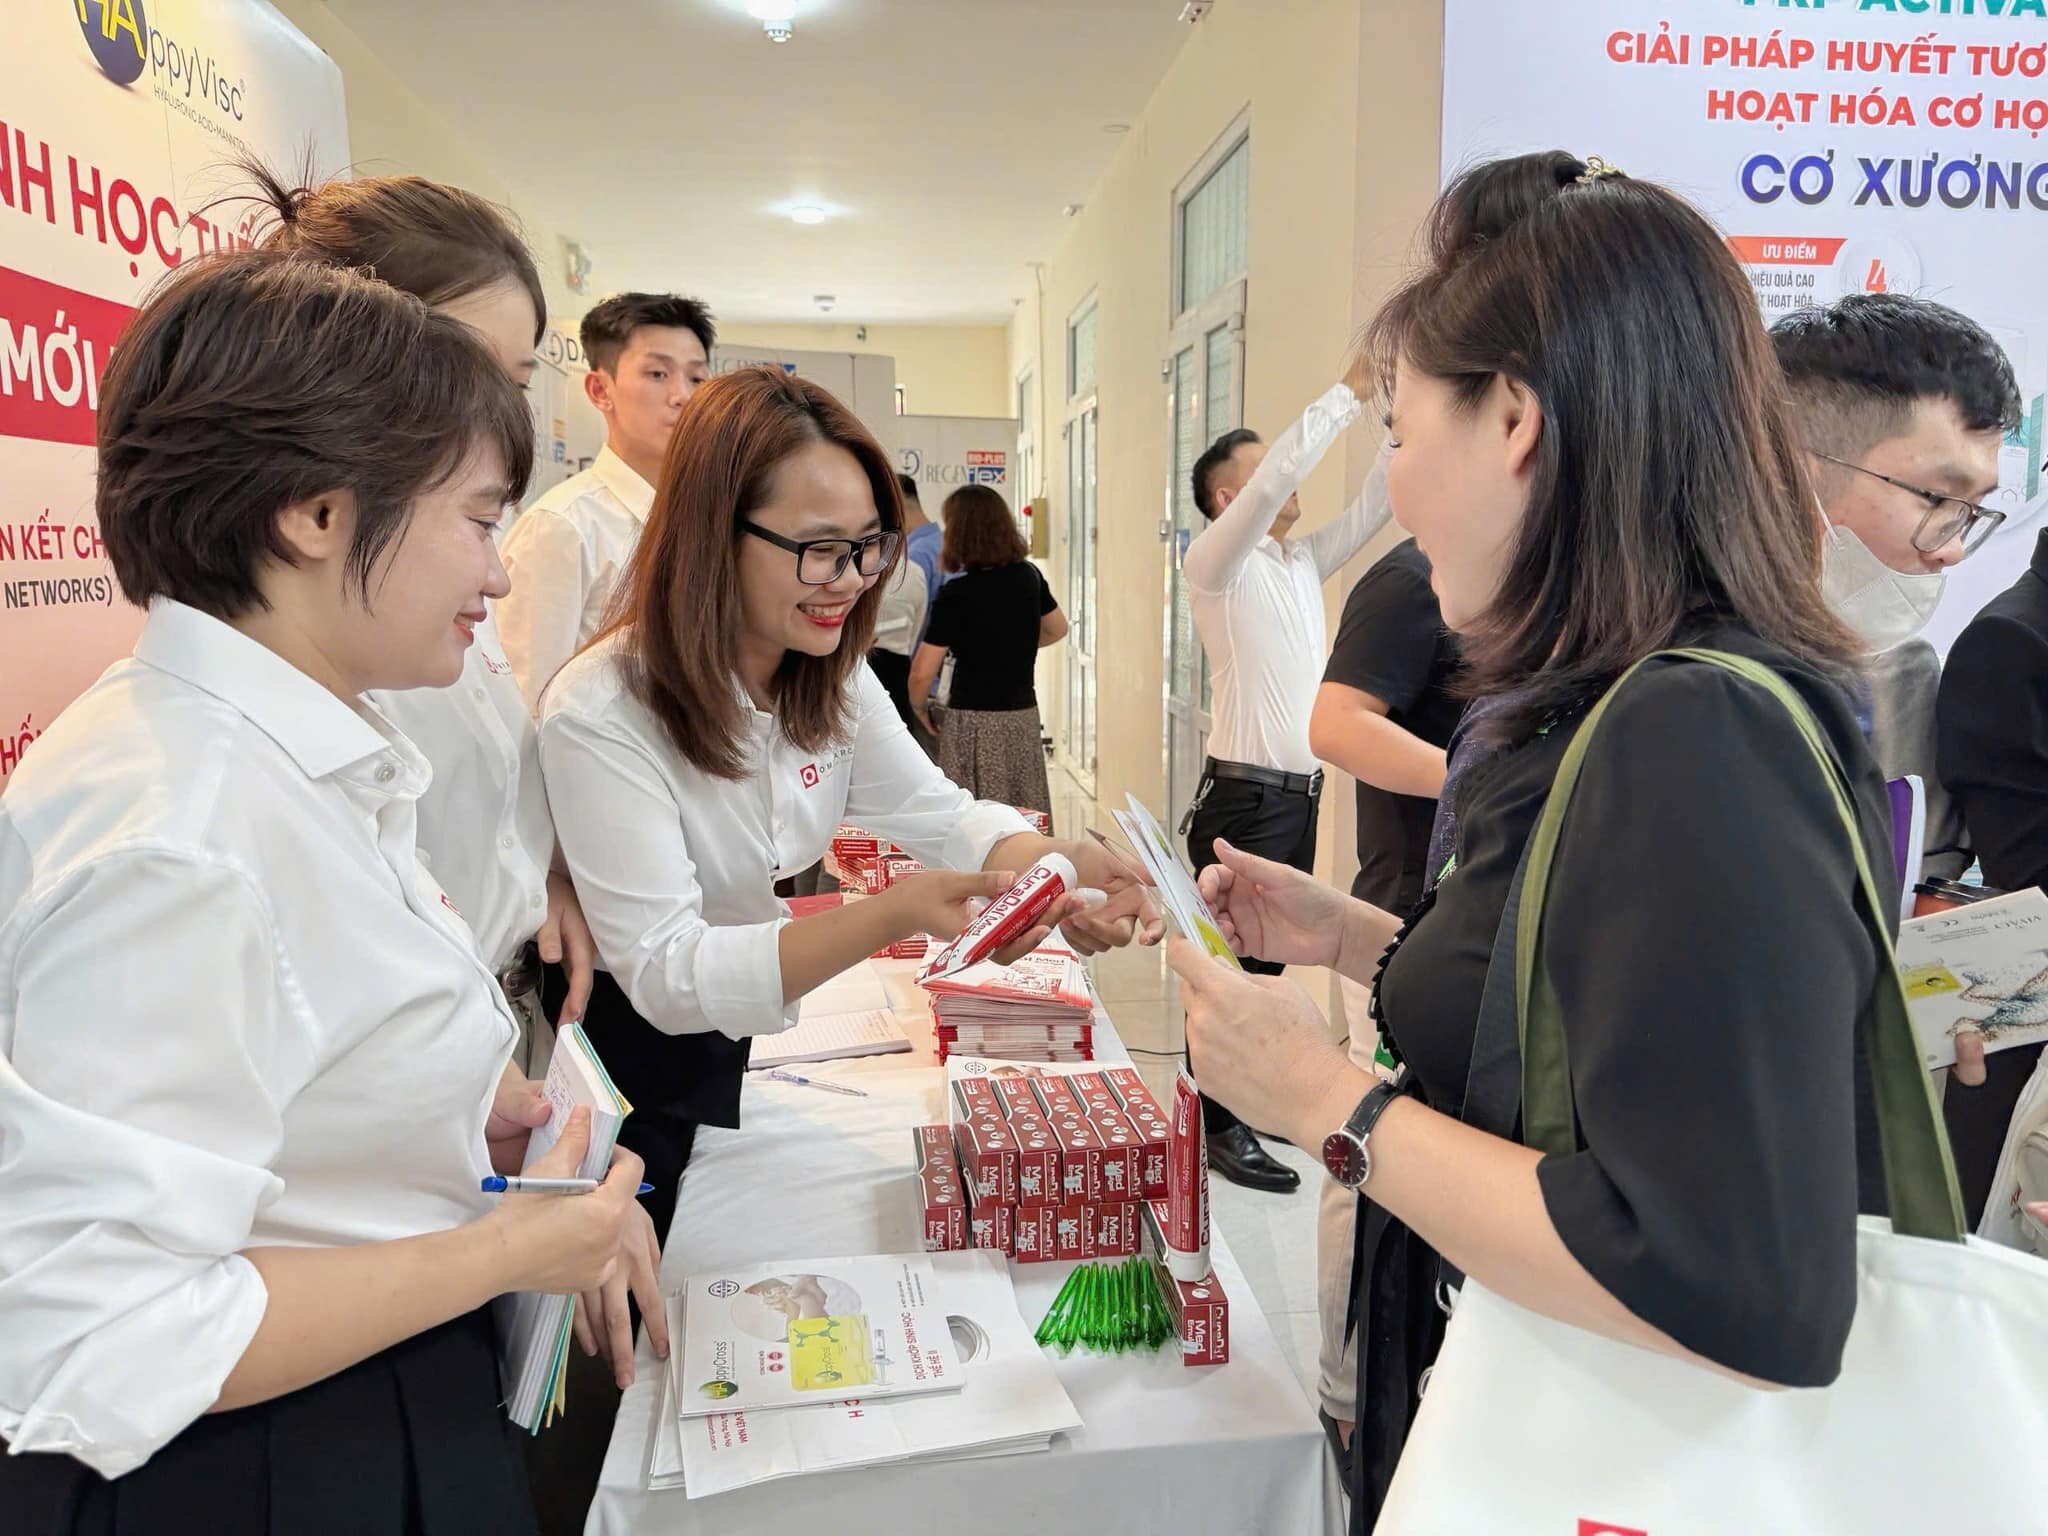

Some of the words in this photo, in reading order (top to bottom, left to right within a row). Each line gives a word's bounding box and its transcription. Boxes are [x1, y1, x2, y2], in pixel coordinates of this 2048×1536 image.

[1606, 21, 1690, 64] GIẢI
[1703, 30, 1815, 69] PHÁP
[1827, 33, 1957, 75] HUYẾT
[1707, 89, 1819, 131] HOẠT
[1829, 87, 1916, 127] HÓA
[1928, 92, 1984, 129] CƠ
[1741, 149, 1835, 205] CƠ
[68, 154, 183, 279] HỌC
[1796, 273, 1815, 288] CAO
[1865, 258, 1887, 292] 4
[0, 309, 99, 411] MỚI
[20, 508, 66, 561] KẾT
[4, 575, 113, 609] NETWORKS)
[988, 1166, 1000, 1195] Med
[1114, 1161, 1125, 1190] Med
[1154, 1155, 1165, 1184] Med
[936, 1221, 946, 1250] Med
[983, 1220, 993, 1249] Med
[1027, 1221, 1037, 1251] Med
[1069, 1219, 1079, 1249] Med
[1109, 1216, 1119, 1245] Med
